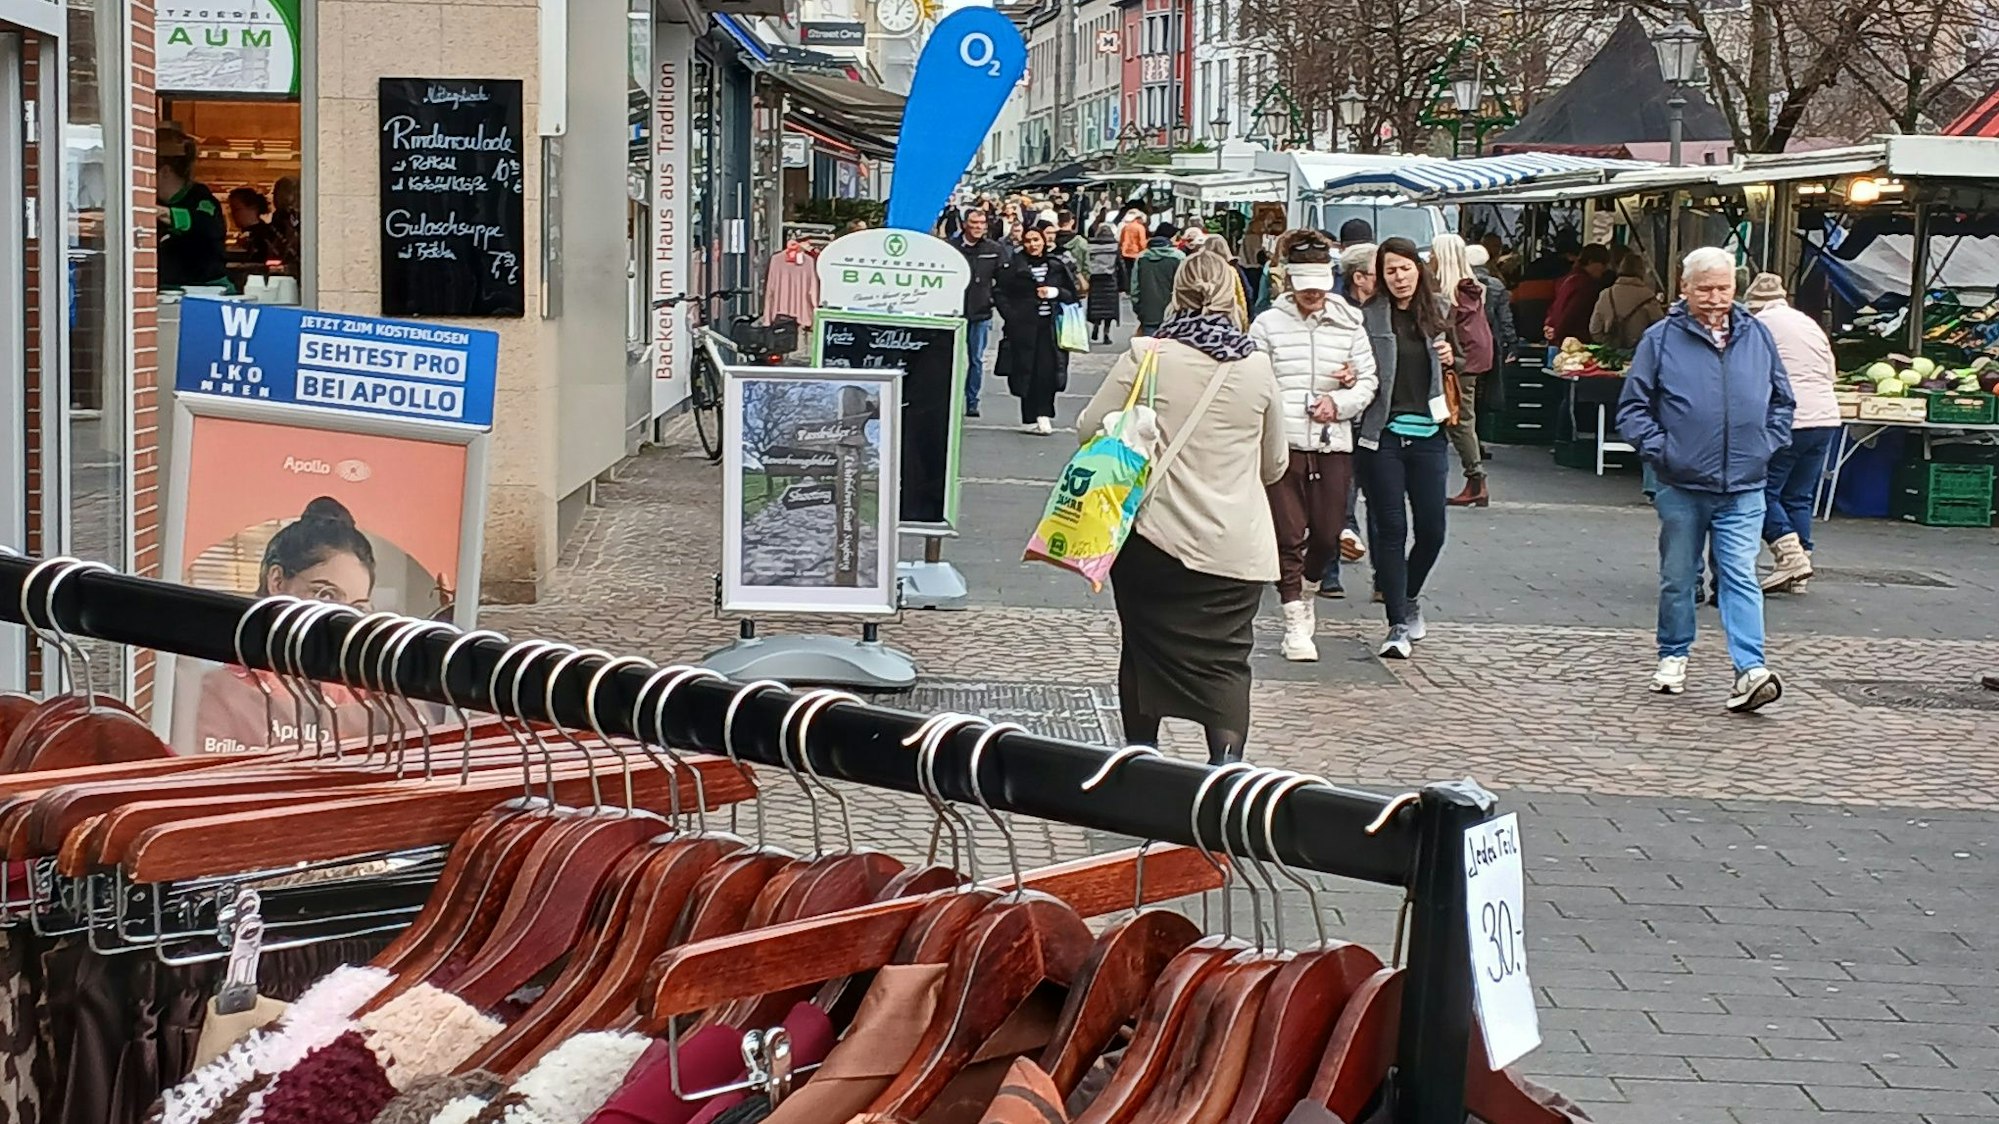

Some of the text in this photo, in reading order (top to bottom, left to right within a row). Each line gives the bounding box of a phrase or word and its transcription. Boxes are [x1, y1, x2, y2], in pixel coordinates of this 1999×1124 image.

[167, 26, 272, 48] AUM
[960, 32, 1001, 76] O2
[656, 62, 676, 155] Tradition
[660, 163, 675, 200] aus
[655, 207, 674, 260] Haus
[656, 270, 674, 294] im
[842, 269, 943, 289] BAUM
[221, 305, 260, 338] W
[300, 315, 469, 345] JETZT ZUM KOSTENLOSEN
[305, 341, 460, 375] SEHTEST PRO
[303, 375, 456, 412] BEI APOLLO
[283, 456, 331, 474] Apollo
[1495, 825, 1517, 857] Teil
